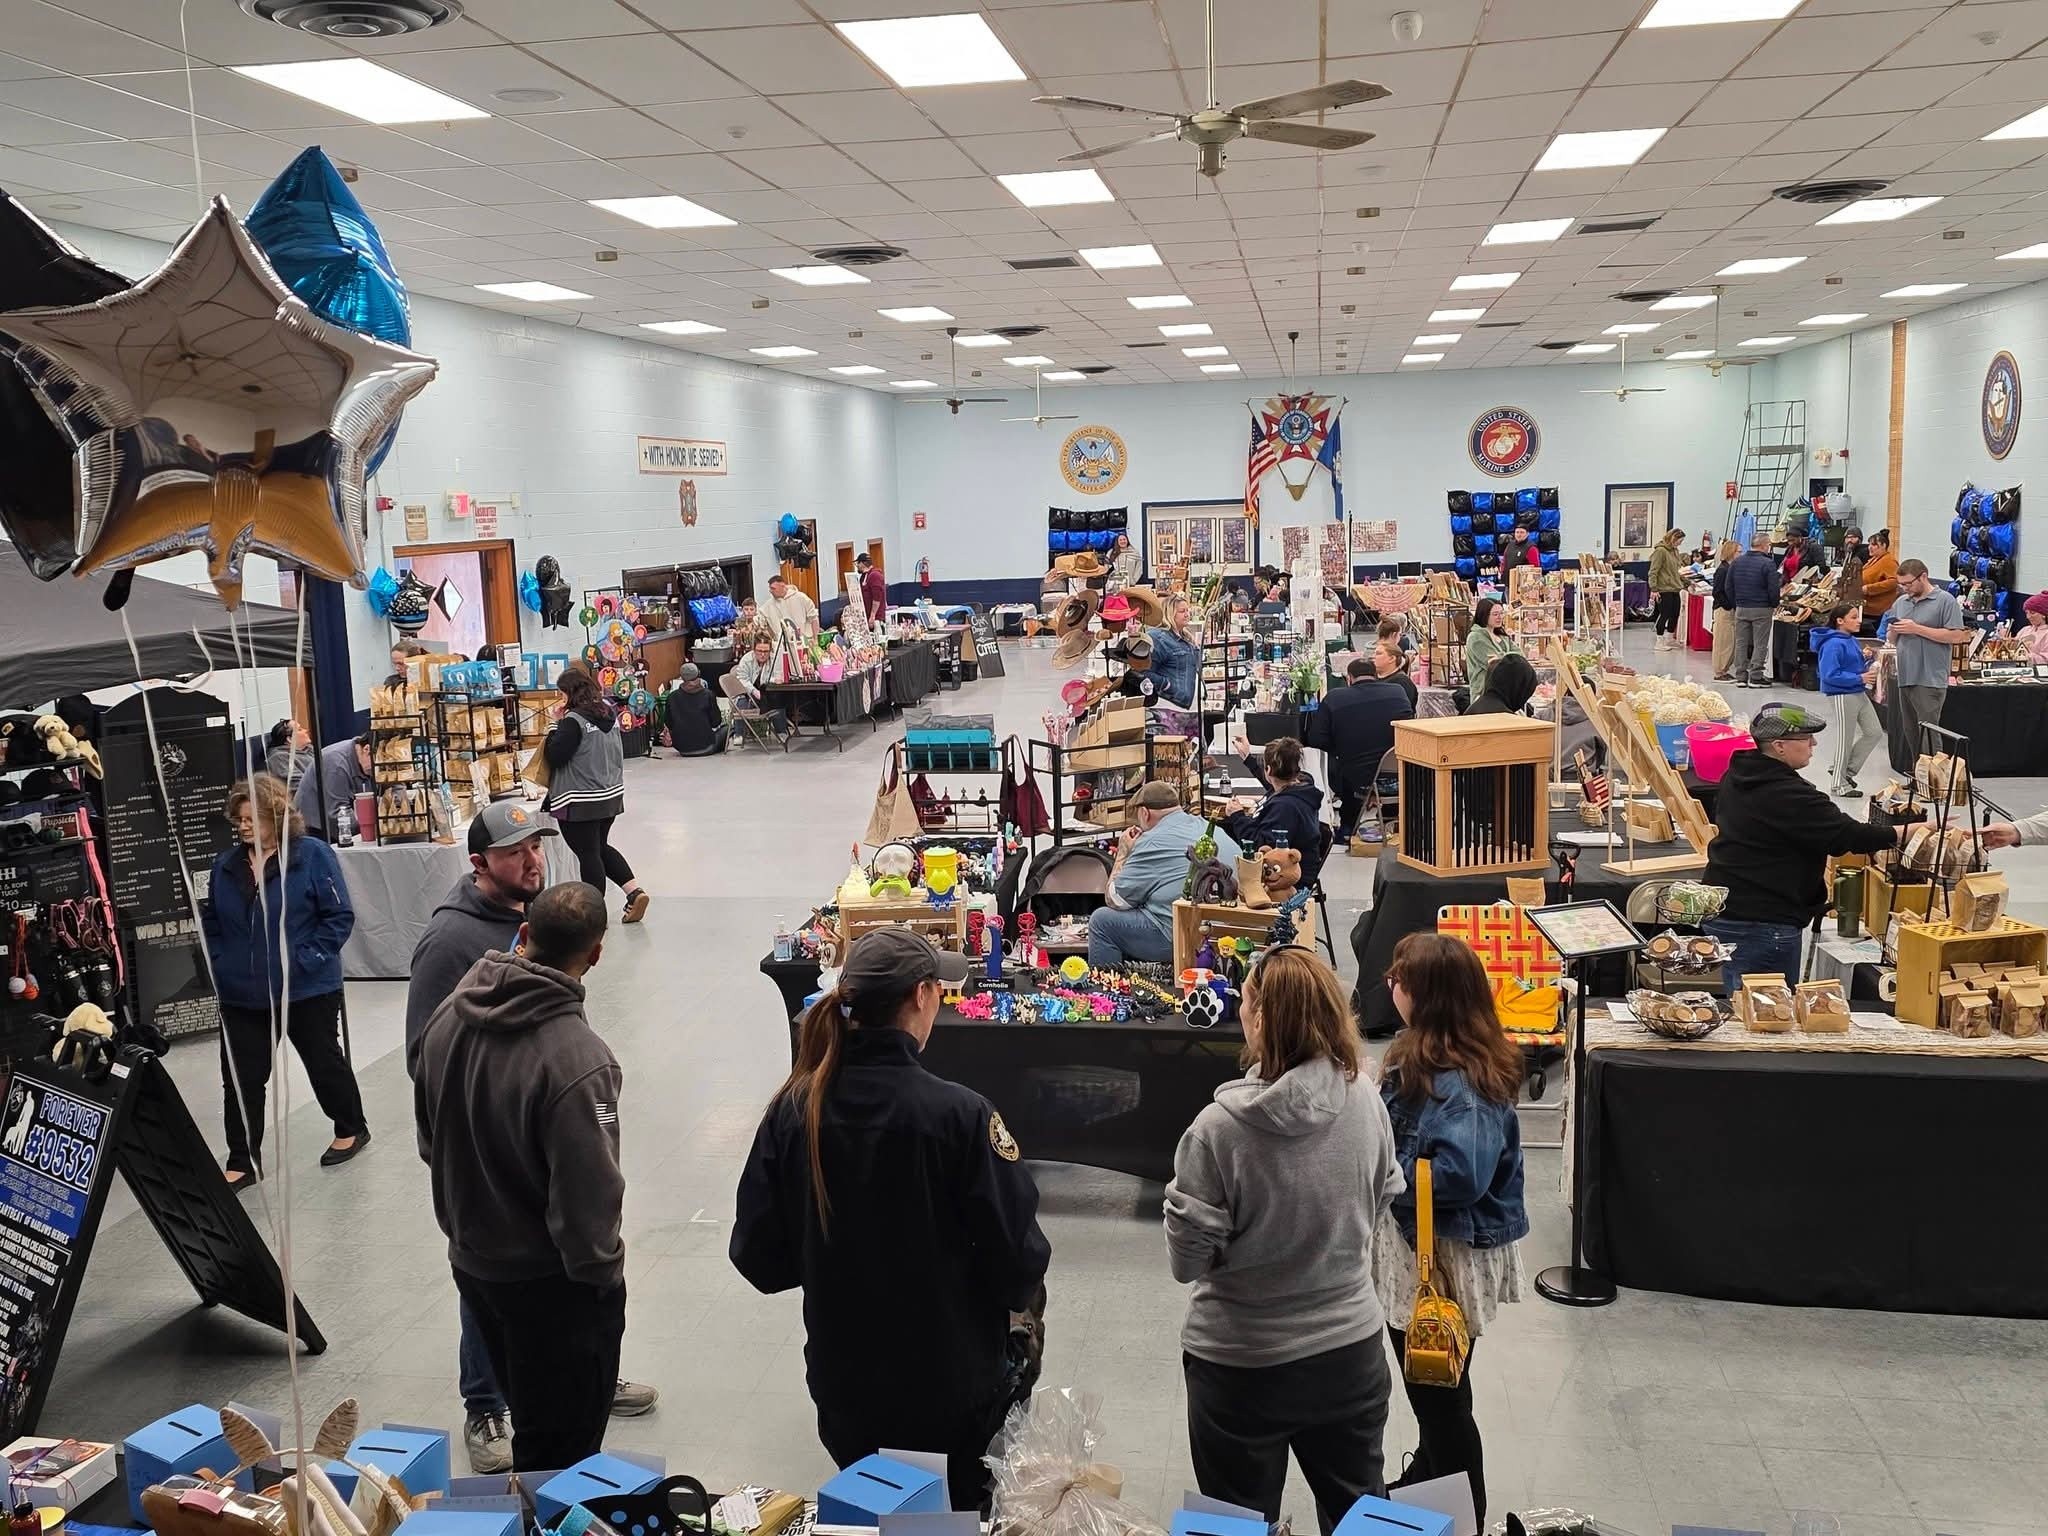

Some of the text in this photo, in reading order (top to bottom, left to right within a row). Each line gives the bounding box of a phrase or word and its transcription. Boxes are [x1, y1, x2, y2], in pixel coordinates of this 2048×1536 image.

[1477, 412, 1532, 432] UNITED STATES
[1063, 428, 1092, 458] DEPARTMENT
[648, 445, 720, 468] WITH HONOR WE SERVED
[1477, 453, 1531, 472] MARINE CORPS
[976, 641, 999, 657] COFFEE
[165, 921, 178, 936] IS
[40, 1092, 101, 1141] FOREVER
[23, 1124, 95, 1189] #9532
